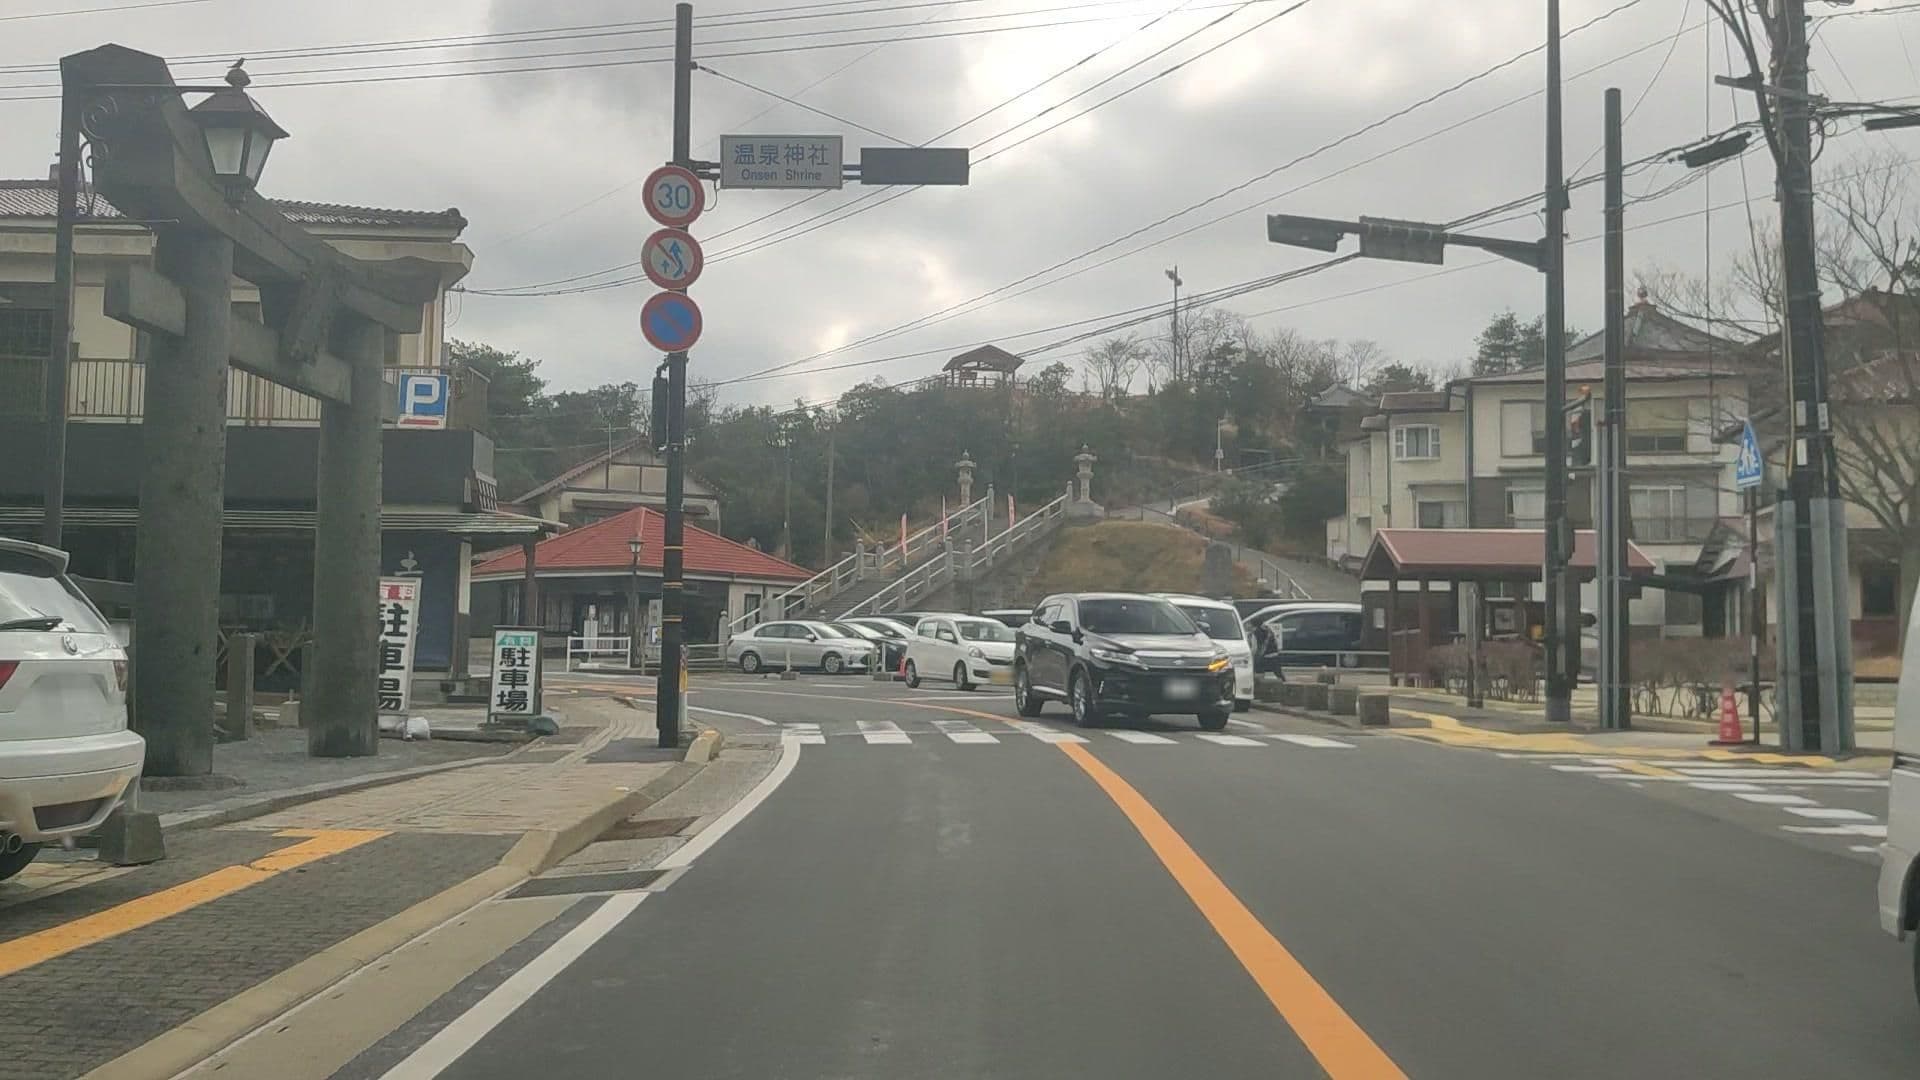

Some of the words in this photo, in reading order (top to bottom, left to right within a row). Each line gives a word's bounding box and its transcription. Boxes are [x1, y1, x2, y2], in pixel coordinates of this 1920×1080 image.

[735, 143, 830, 165] 温泉神社
[741, 168, 777, 181] Onsen
[786, 168, 822, 181] Shrine
[658, 183, 690, 210] 30
[405, 376, 440, 414] P
[495, 646, 531, 712] 駐車場
